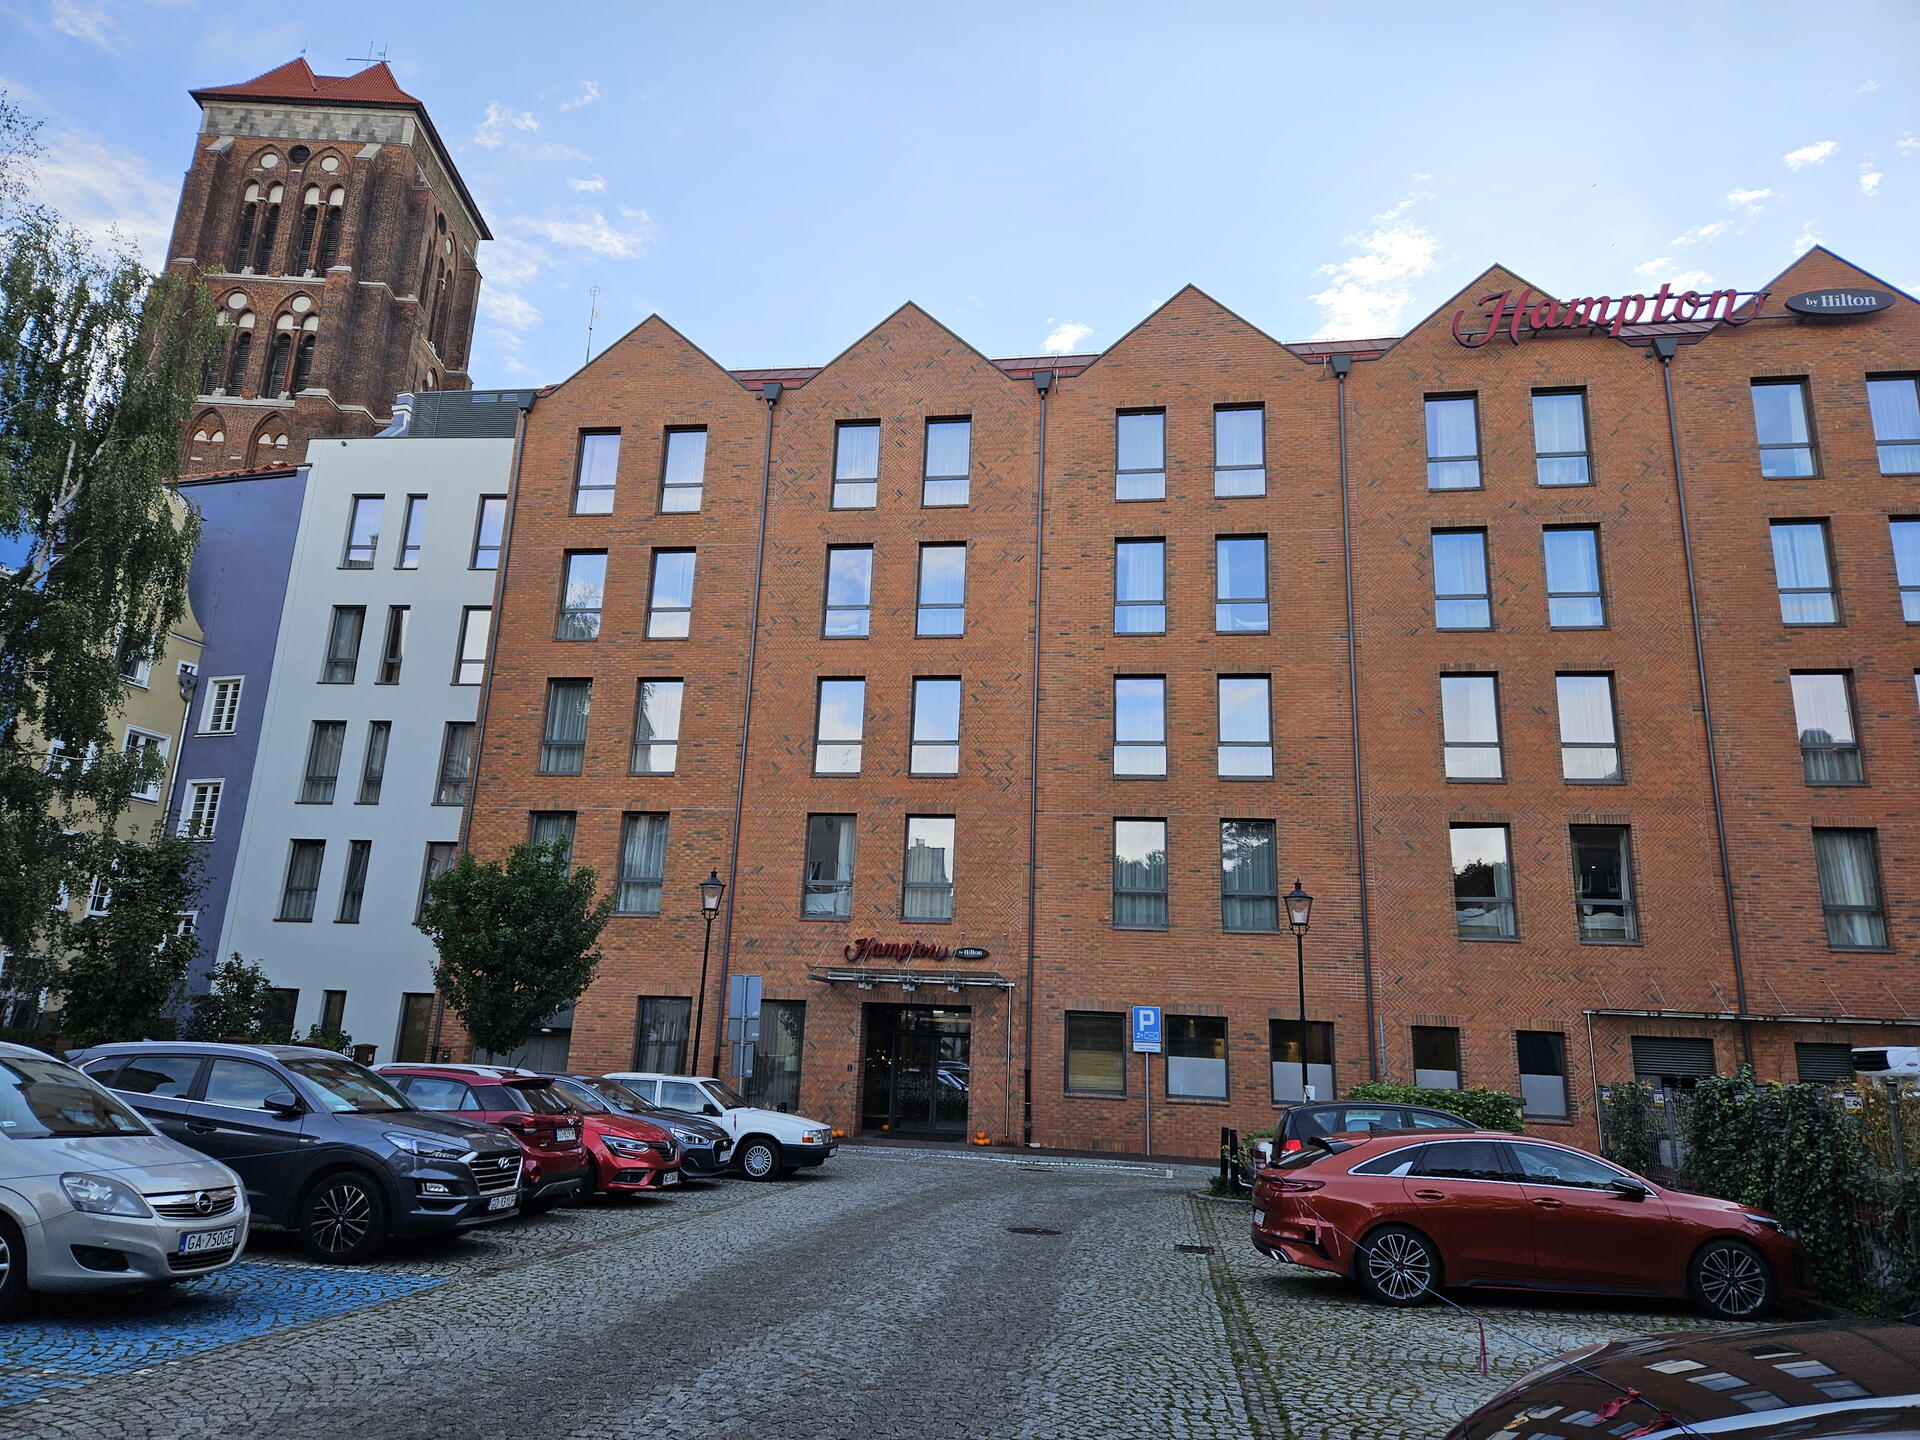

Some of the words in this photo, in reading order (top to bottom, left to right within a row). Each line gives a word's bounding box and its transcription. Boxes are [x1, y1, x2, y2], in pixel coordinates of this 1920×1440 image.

[1452, 283, 1772, 348] Hampton
[1805, 297, 1818, 307] by
[1820, 293, 1878, 307] Hilton
[844, 937, 948, 961] Hampton
[963, 948, 983, 956] Hilton
[1139, 1009, 1155, 1031] P
[187, 1234, 202, 1250] GA
[204, 1229, 234, 1248] 750GE
